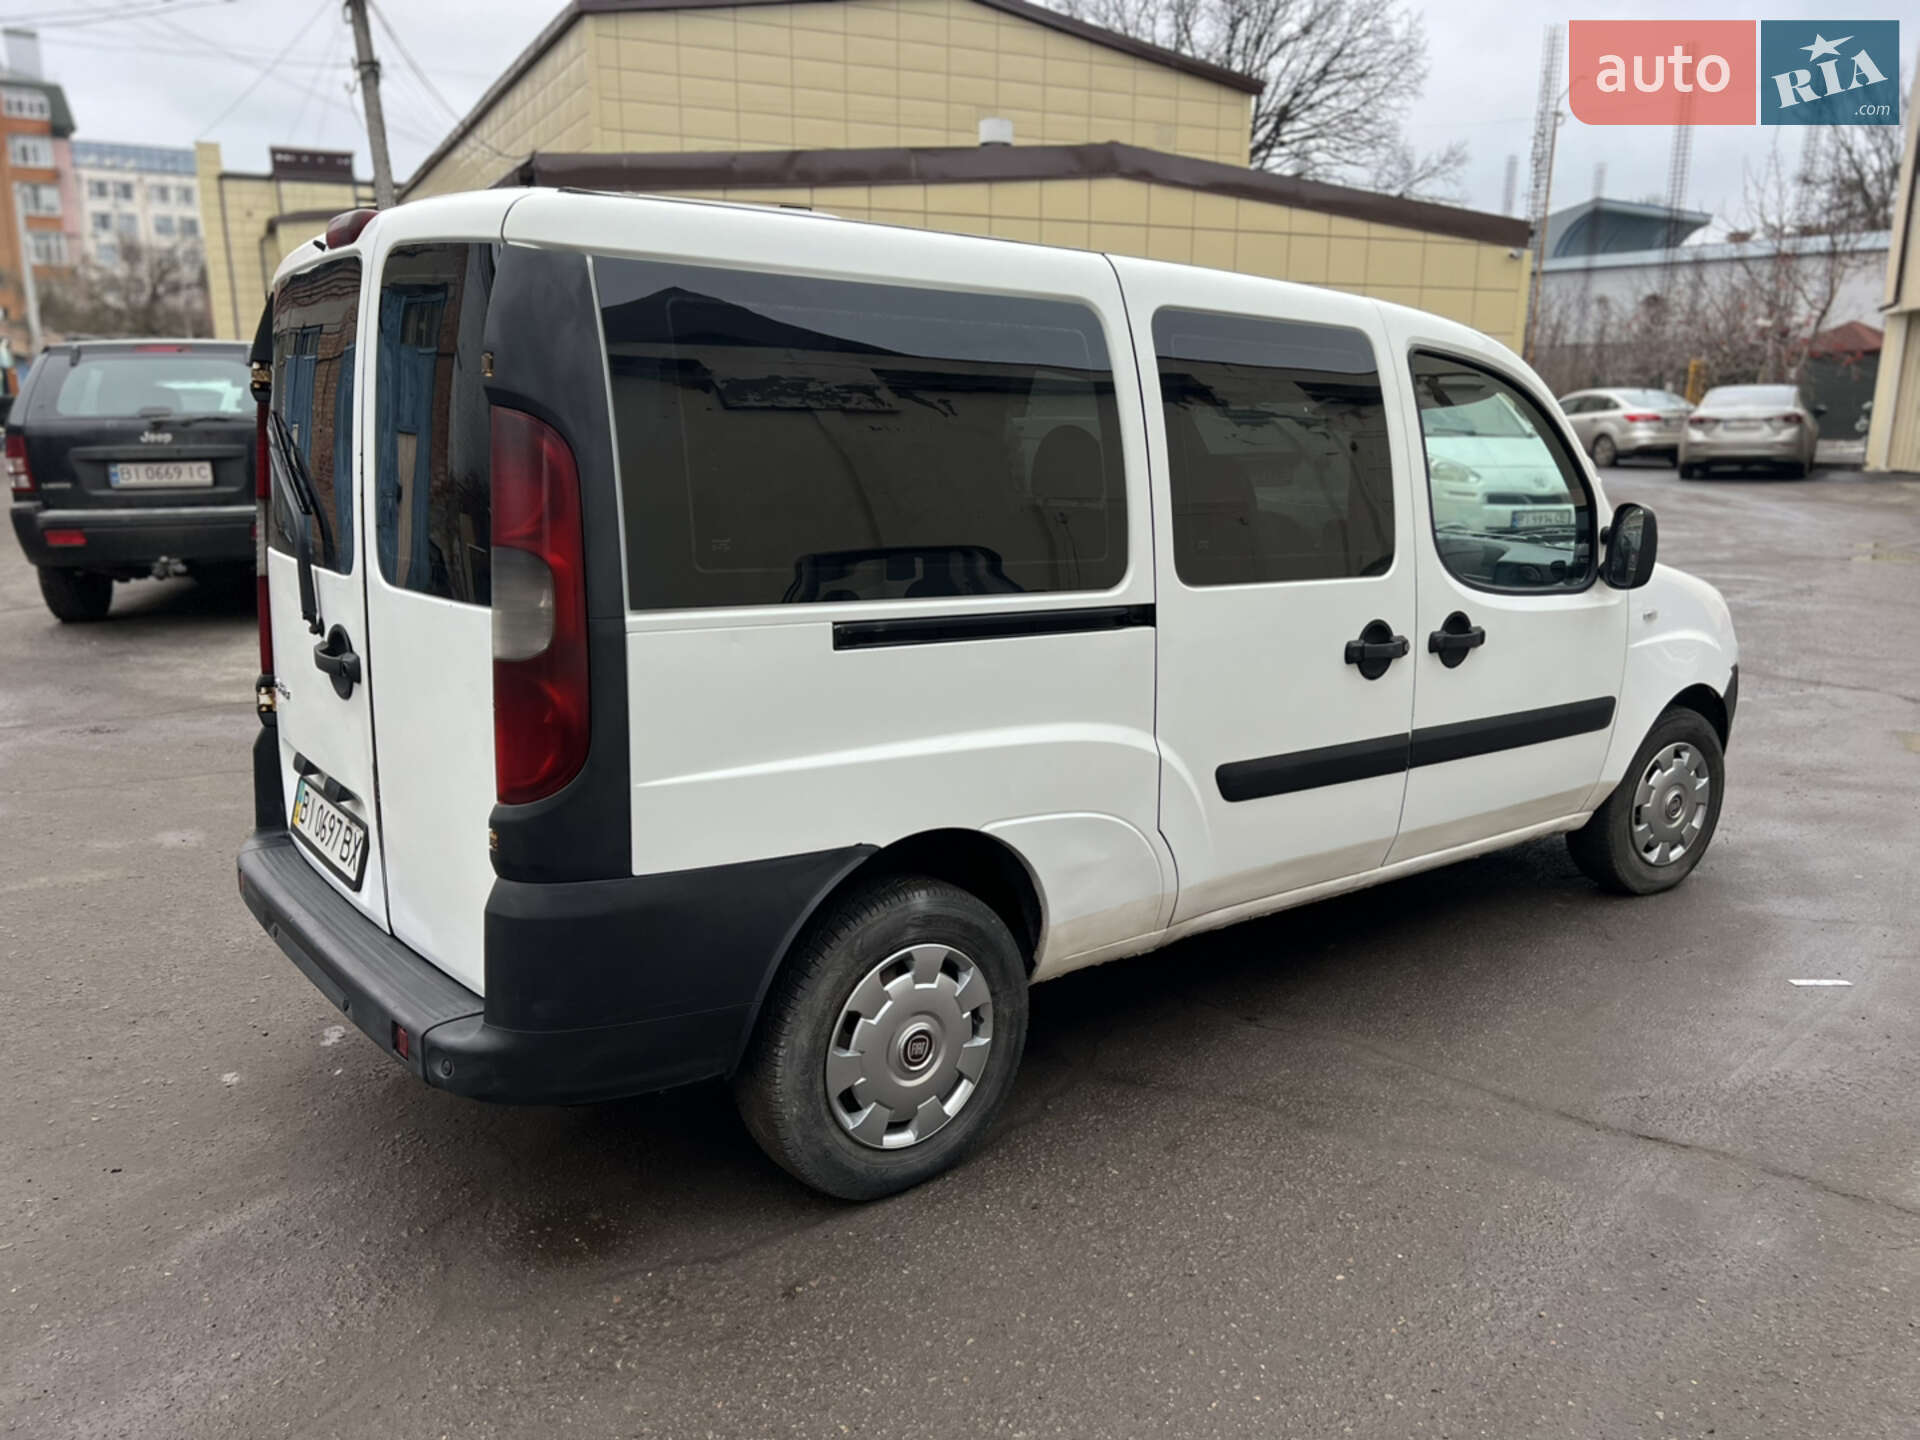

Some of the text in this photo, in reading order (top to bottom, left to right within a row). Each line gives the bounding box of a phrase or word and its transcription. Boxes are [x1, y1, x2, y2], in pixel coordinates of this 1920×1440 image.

[140, 431, 173, 444] Jeep
[145, 466, 182, 480] 0669
[315, 803, 343, 852] 0697
[340, 825, 363, 872] BX
